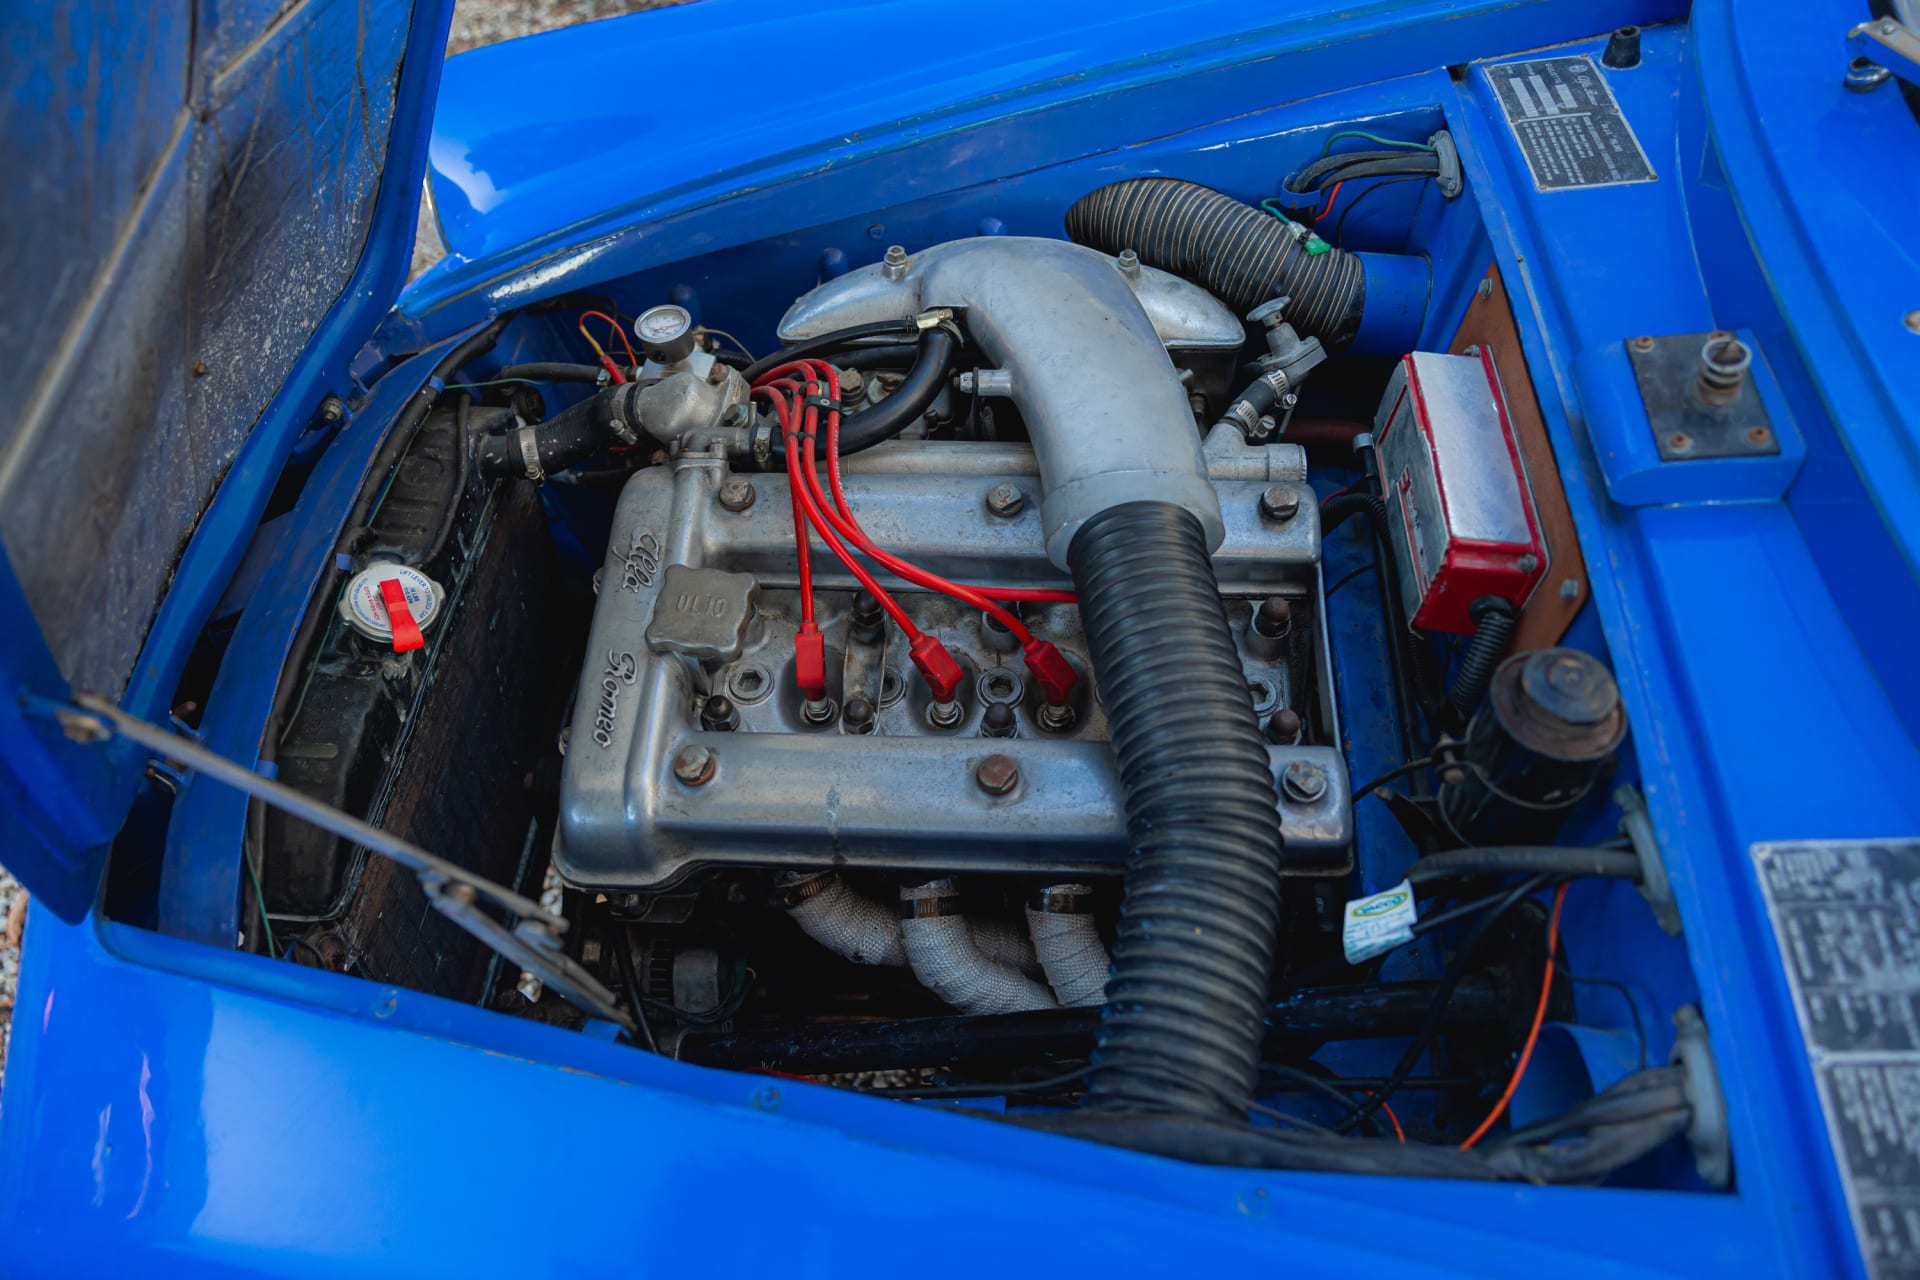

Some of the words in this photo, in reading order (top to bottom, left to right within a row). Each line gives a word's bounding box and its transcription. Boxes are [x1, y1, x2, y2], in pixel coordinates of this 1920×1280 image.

[400, 569, 412, 577] LIFT
[411, 573, 427, 588] LEVER
[613, 526, 660, 594] Alfa
[593, 649, 638, 749] Romeo
